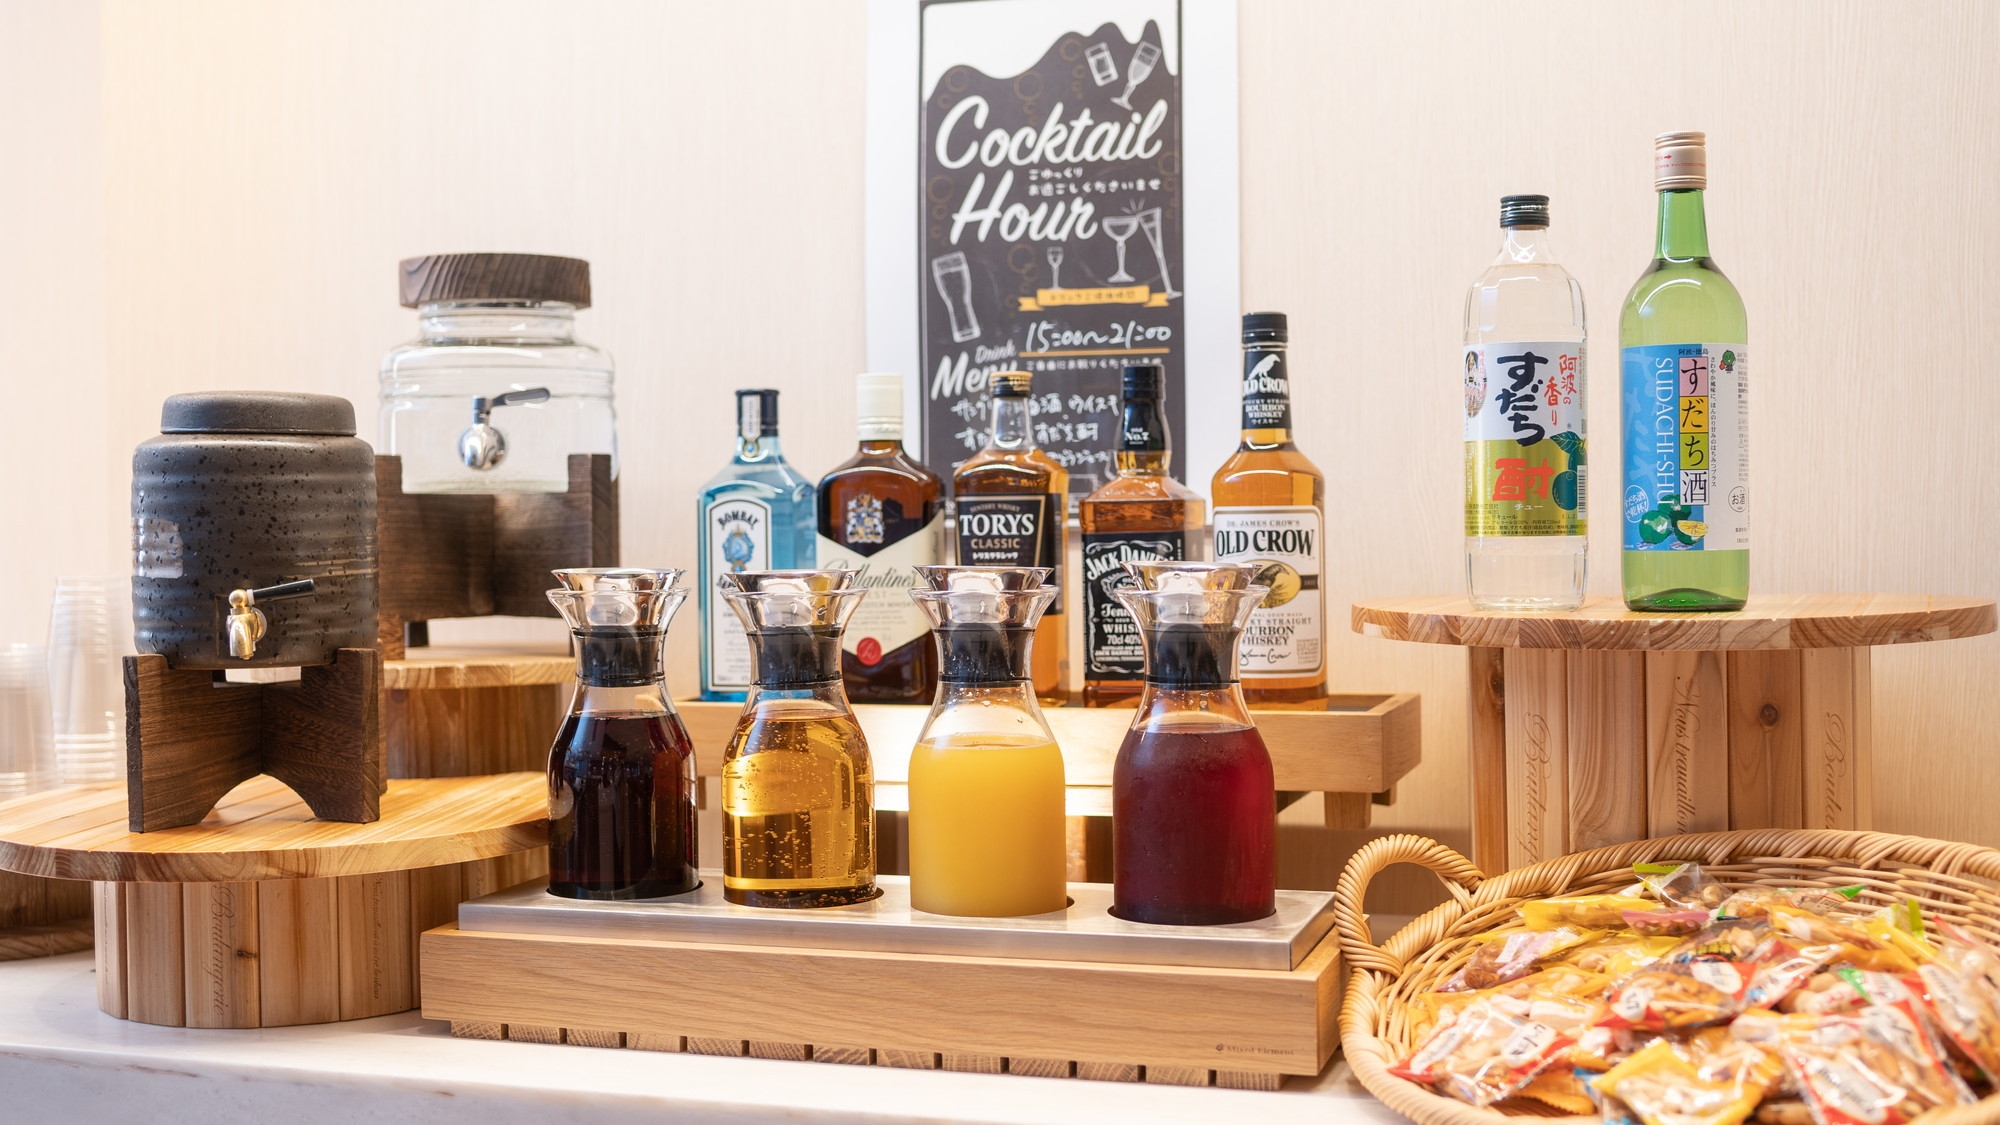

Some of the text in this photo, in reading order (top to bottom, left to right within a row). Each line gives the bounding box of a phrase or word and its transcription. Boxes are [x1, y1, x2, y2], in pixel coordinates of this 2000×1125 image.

[935, 95, 1168, 169] Cocktail
[1028, 167, 1083, 181] ごゆっくり
[950, 168, 1099, 245] Hour
[974, 338, 1017, 364] Drink
[1559, 354, 1577, 405] 阿波の
[1068, 394, 1120, 417] ウイスキ
[1245, 404, 1286, 412] BOURBON
[1495, 352, 1549, 448] すだち
[1543, 376, 1563, 426] 香り
[1655, 358, 1675, 504] SUDACHI-SHU
[1680, 359, 1707, 503] すだち酒
[1492, 457, 1555, 502] 酎
[718, 511, 759, 531] BOMBAY
[1514, 503, 1544, 511] チュー
[960, 513, 1035, 537] TORYS
[1269, 519, 1301, 527] CROW'S
[970, 538, 1021, 549] CLASSIC
[1216, 529, 1315, 557] OLD CROW
[1085, 551, 1121, 581] JACK
[1266, 617, 1312, 626] STRAIGHT
[201, 884, 236, 1017] Boulangerie
